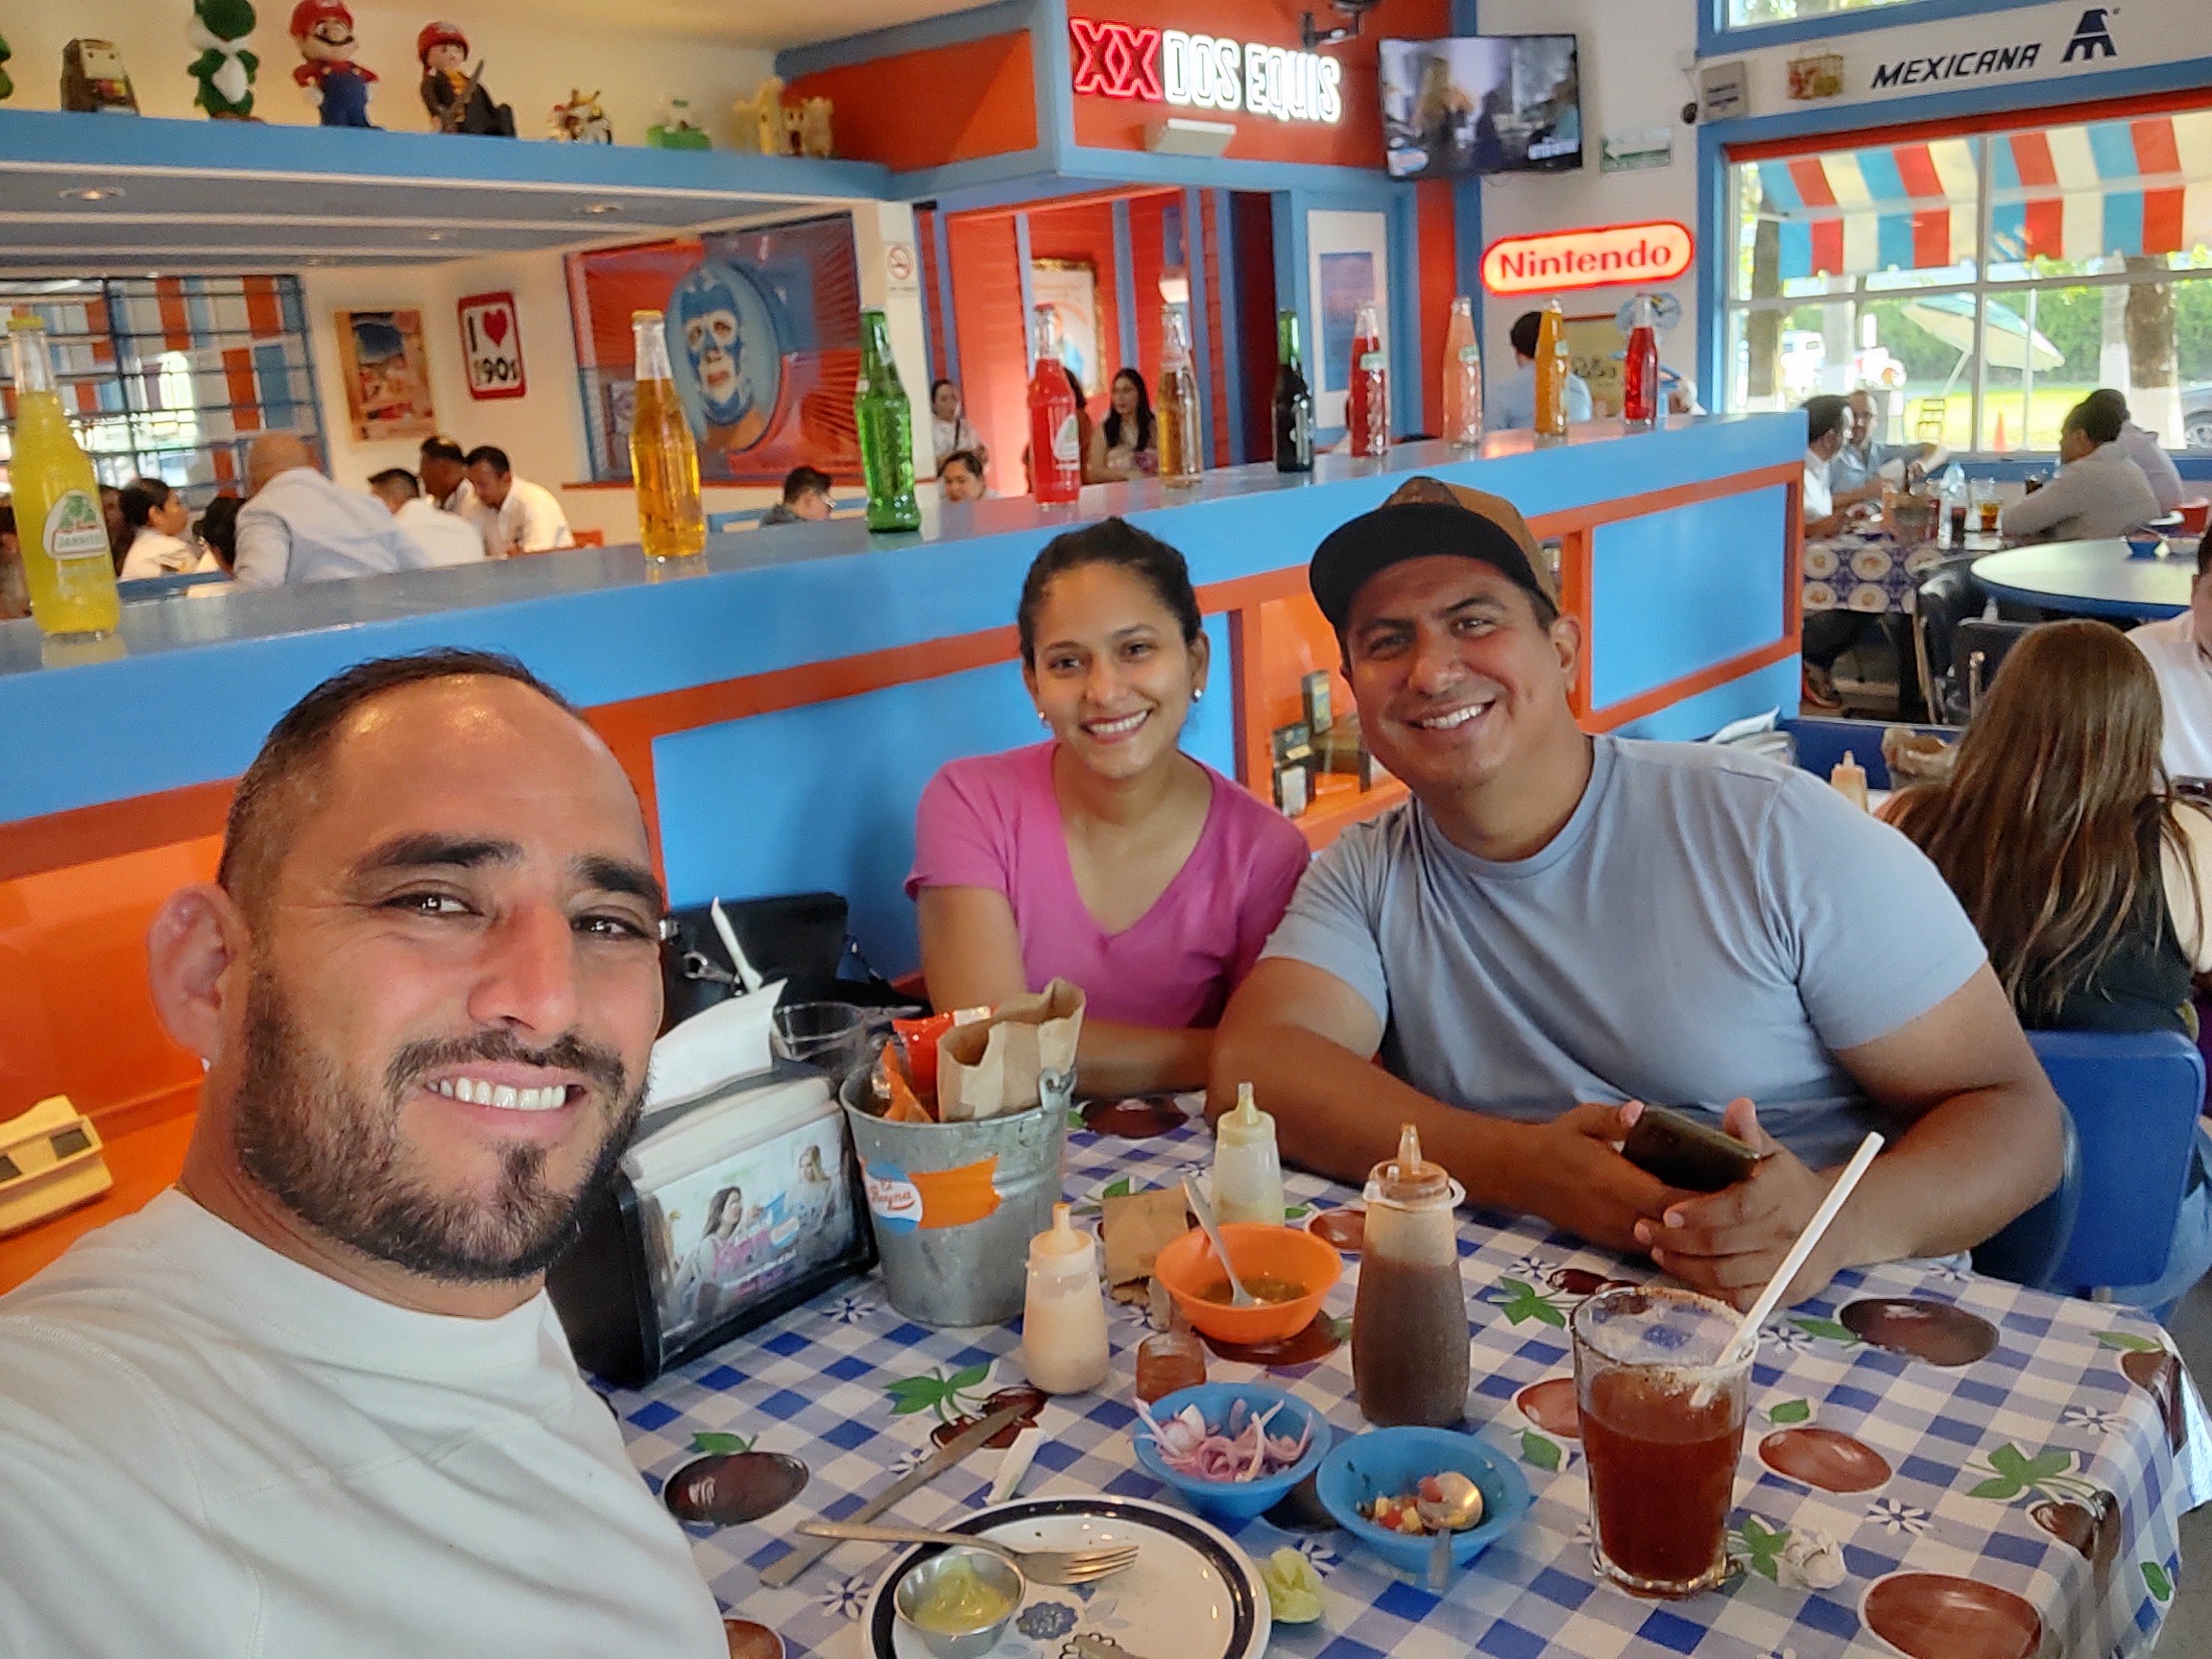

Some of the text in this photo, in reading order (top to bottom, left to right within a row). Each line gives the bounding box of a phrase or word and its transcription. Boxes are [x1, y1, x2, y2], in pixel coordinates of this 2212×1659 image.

[1070, 18, 1341, 123] XX DOS EQUIS
[1871, 43, 2041, 88] MEXICANA
[1500, 240, 1671, 278] Nintendo
